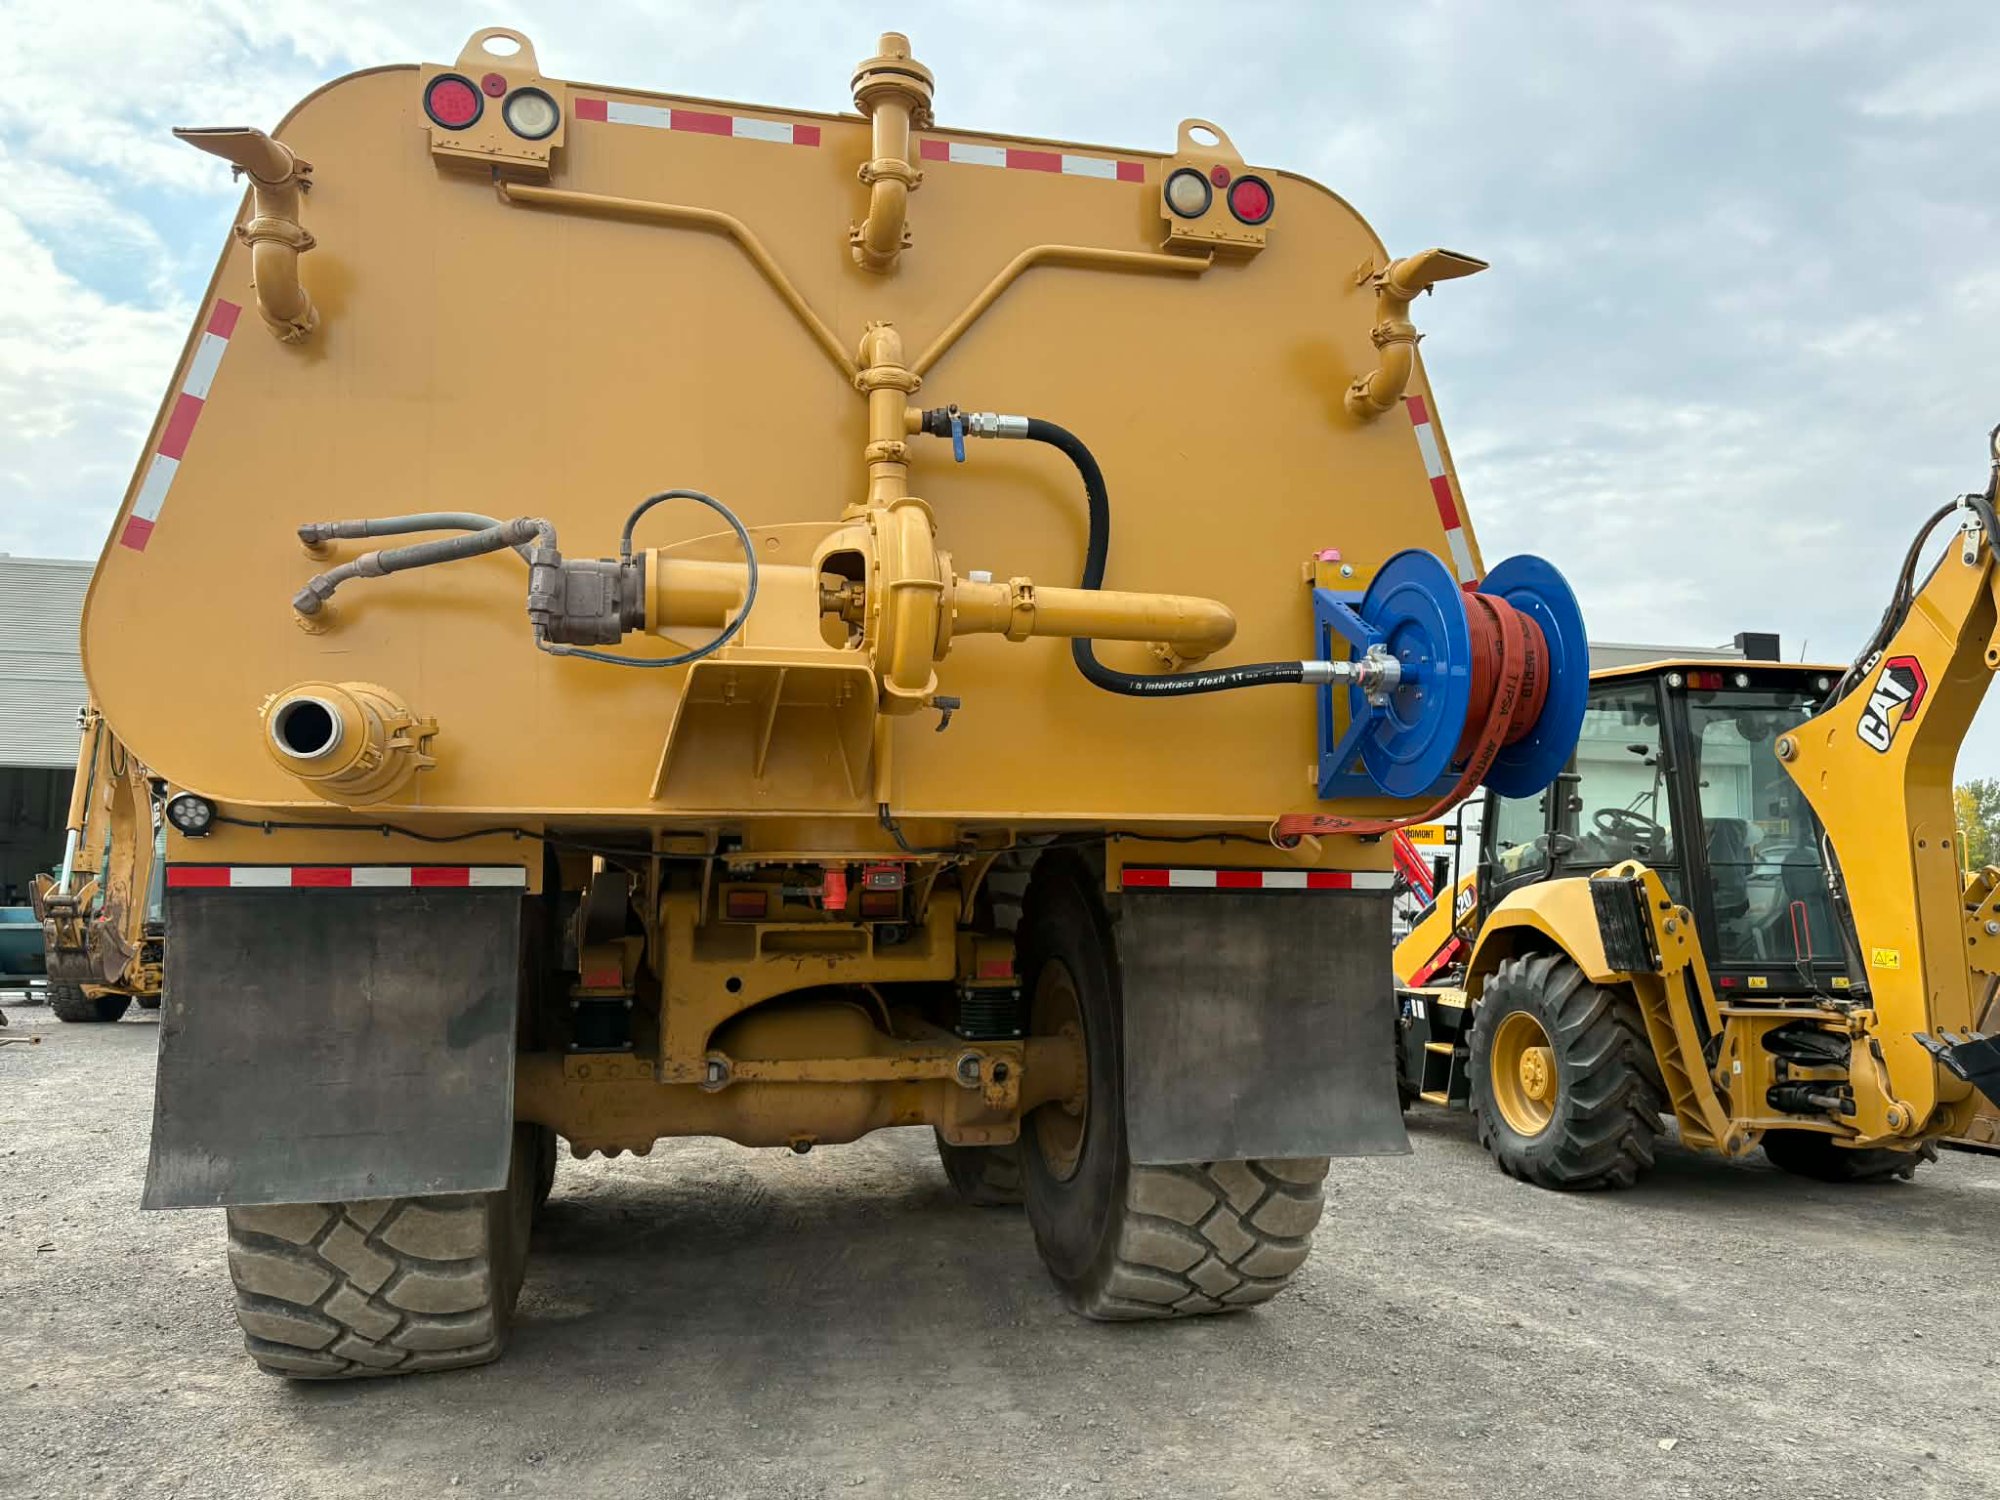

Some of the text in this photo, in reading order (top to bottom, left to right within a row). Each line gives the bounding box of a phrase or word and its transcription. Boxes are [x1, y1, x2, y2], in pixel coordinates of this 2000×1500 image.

[1500, 674, 1520, 716] TIPSA
[1858, 667, 1912, 752] CAT
[1446, 829, 1457, 840] CA
